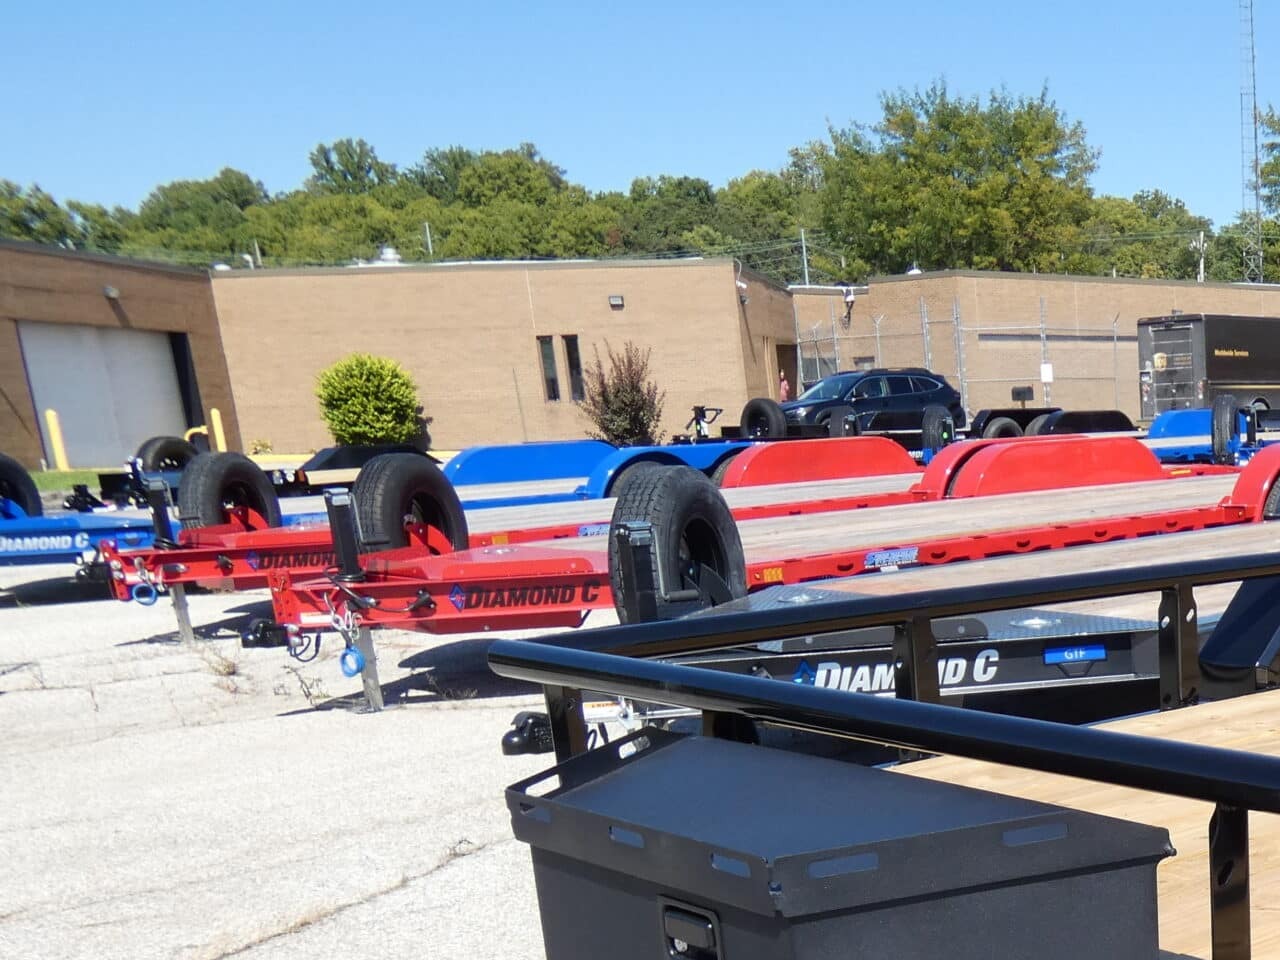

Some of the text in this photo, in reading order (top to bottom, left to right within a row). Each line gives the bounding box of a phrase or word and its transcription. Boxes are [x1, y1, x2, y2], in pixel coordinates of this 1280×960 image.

[75, 532, 89, 549] C
[259, 551, 337, 570] DIAMON
[465, 579, 600, 610] DIAMOND C
[814, 649, 999, 692] DIAMD C
